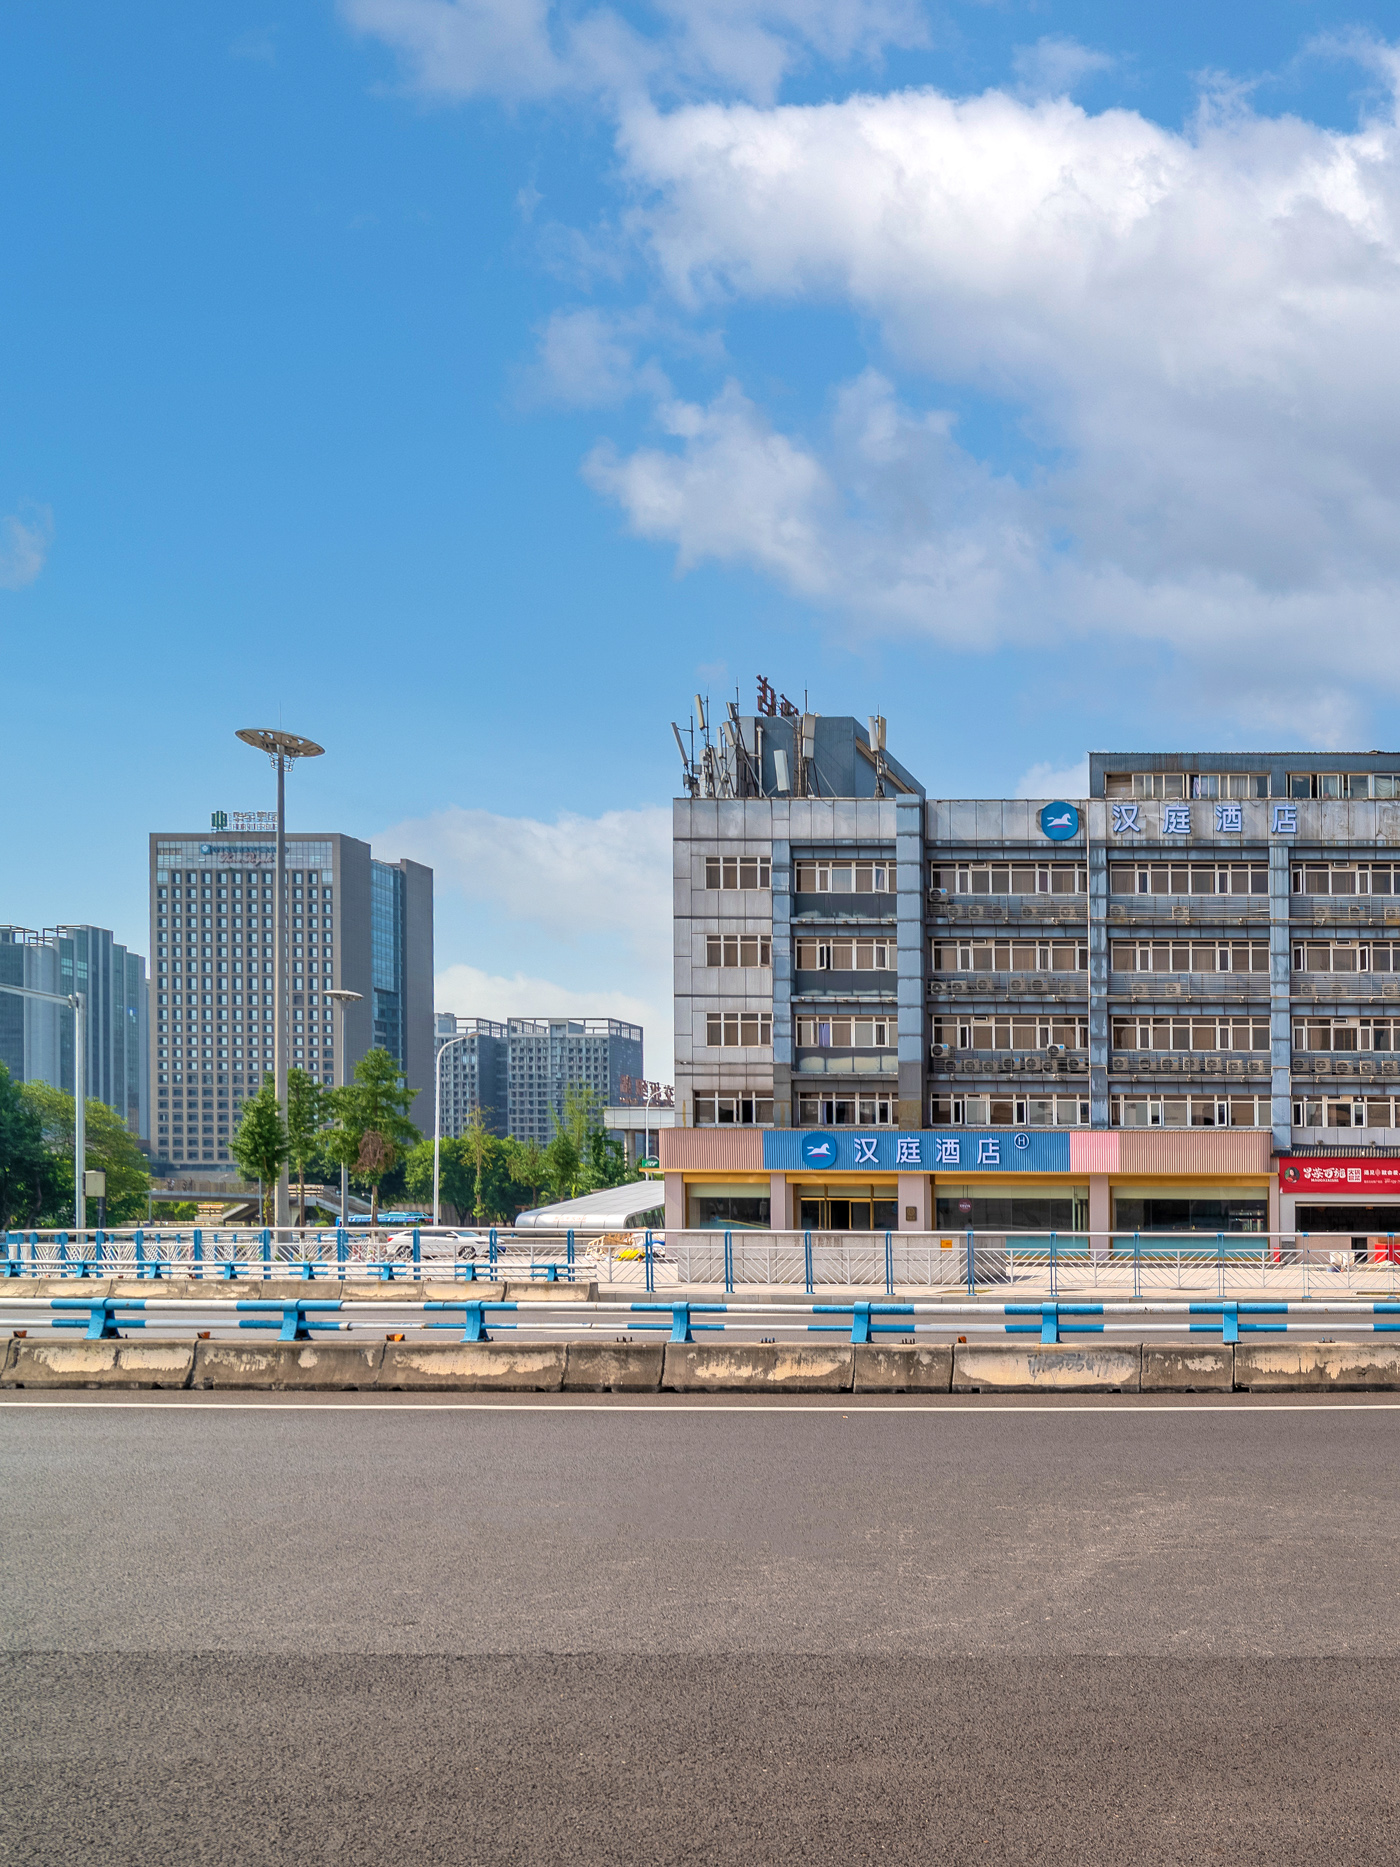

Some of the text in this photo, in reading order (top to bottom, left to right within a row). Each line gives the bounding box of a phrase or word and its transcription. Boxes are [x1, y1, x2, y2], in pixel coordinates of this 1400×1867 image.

[1112, 804, 1297, 834] 汉庭酒店
[854, 1137, 1000, 1164] 汉庭酒店
